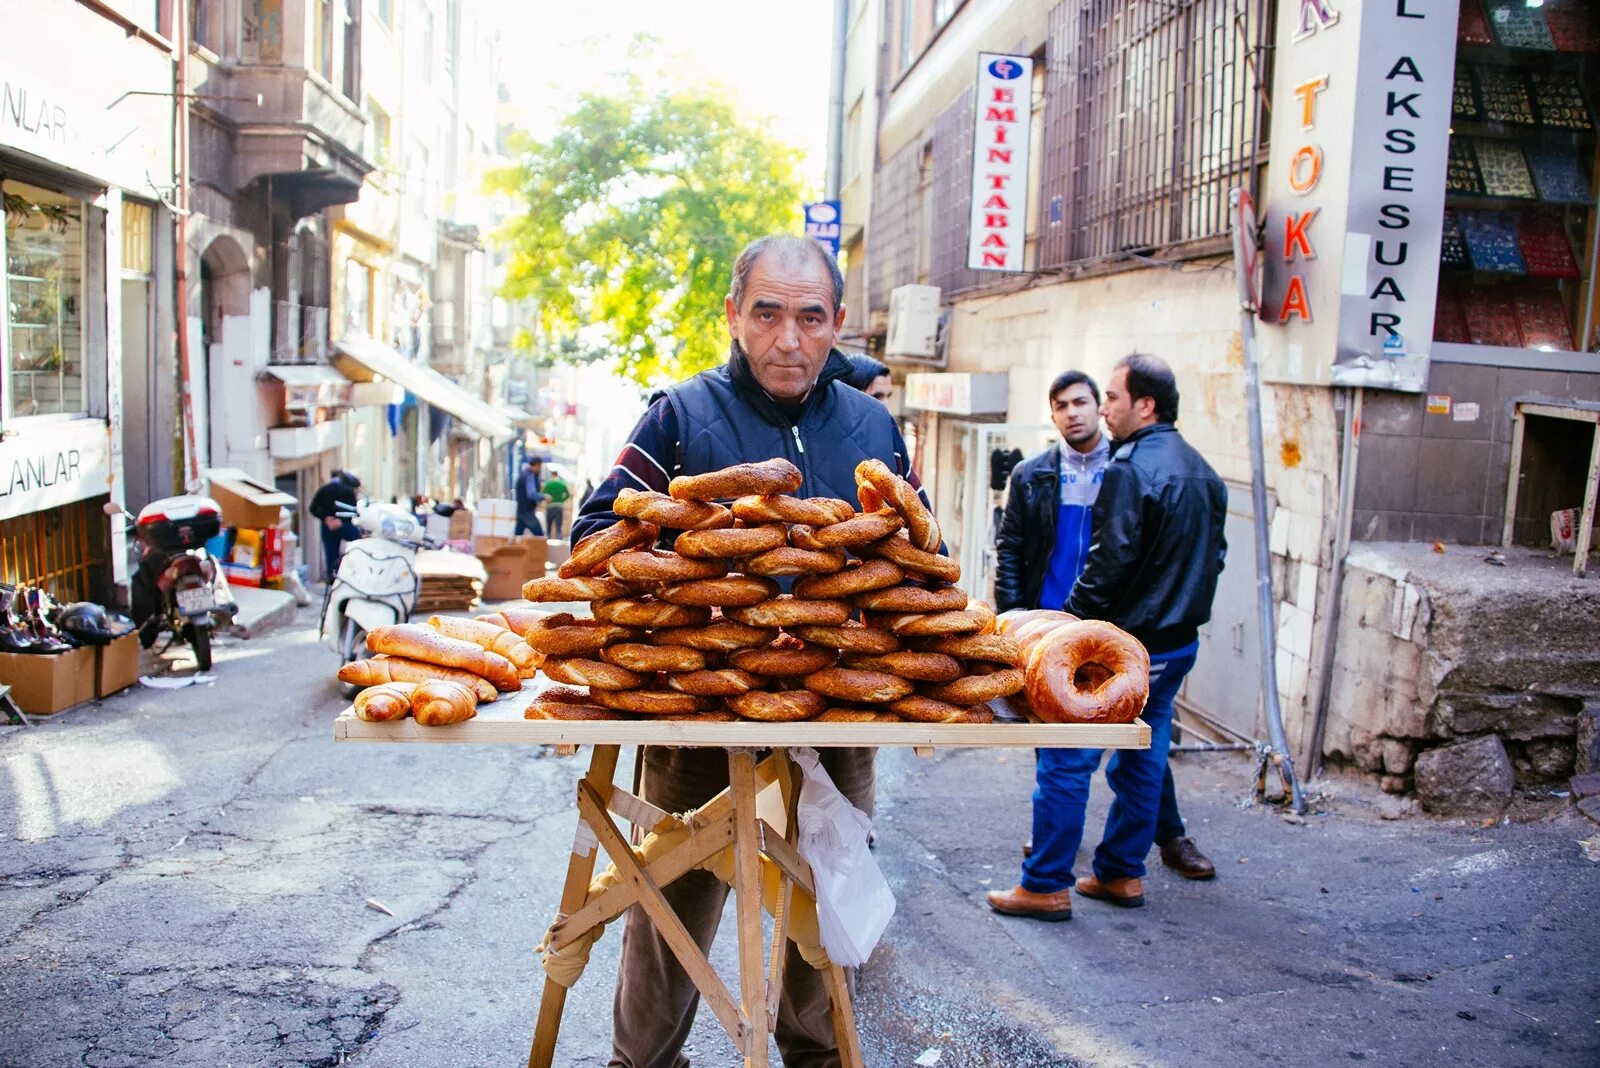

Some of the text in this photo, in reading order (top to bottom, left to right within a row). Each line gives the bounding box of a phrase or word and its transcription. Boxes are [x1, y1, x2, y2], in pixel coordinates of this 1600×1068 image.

[2, 81, 66, 144] NLAR
[1279, 73, 1329, 323] TOKA
[1369, 56, 1424, 337] AKSESUAR
[981, 173, 1010, 268] TABAN
